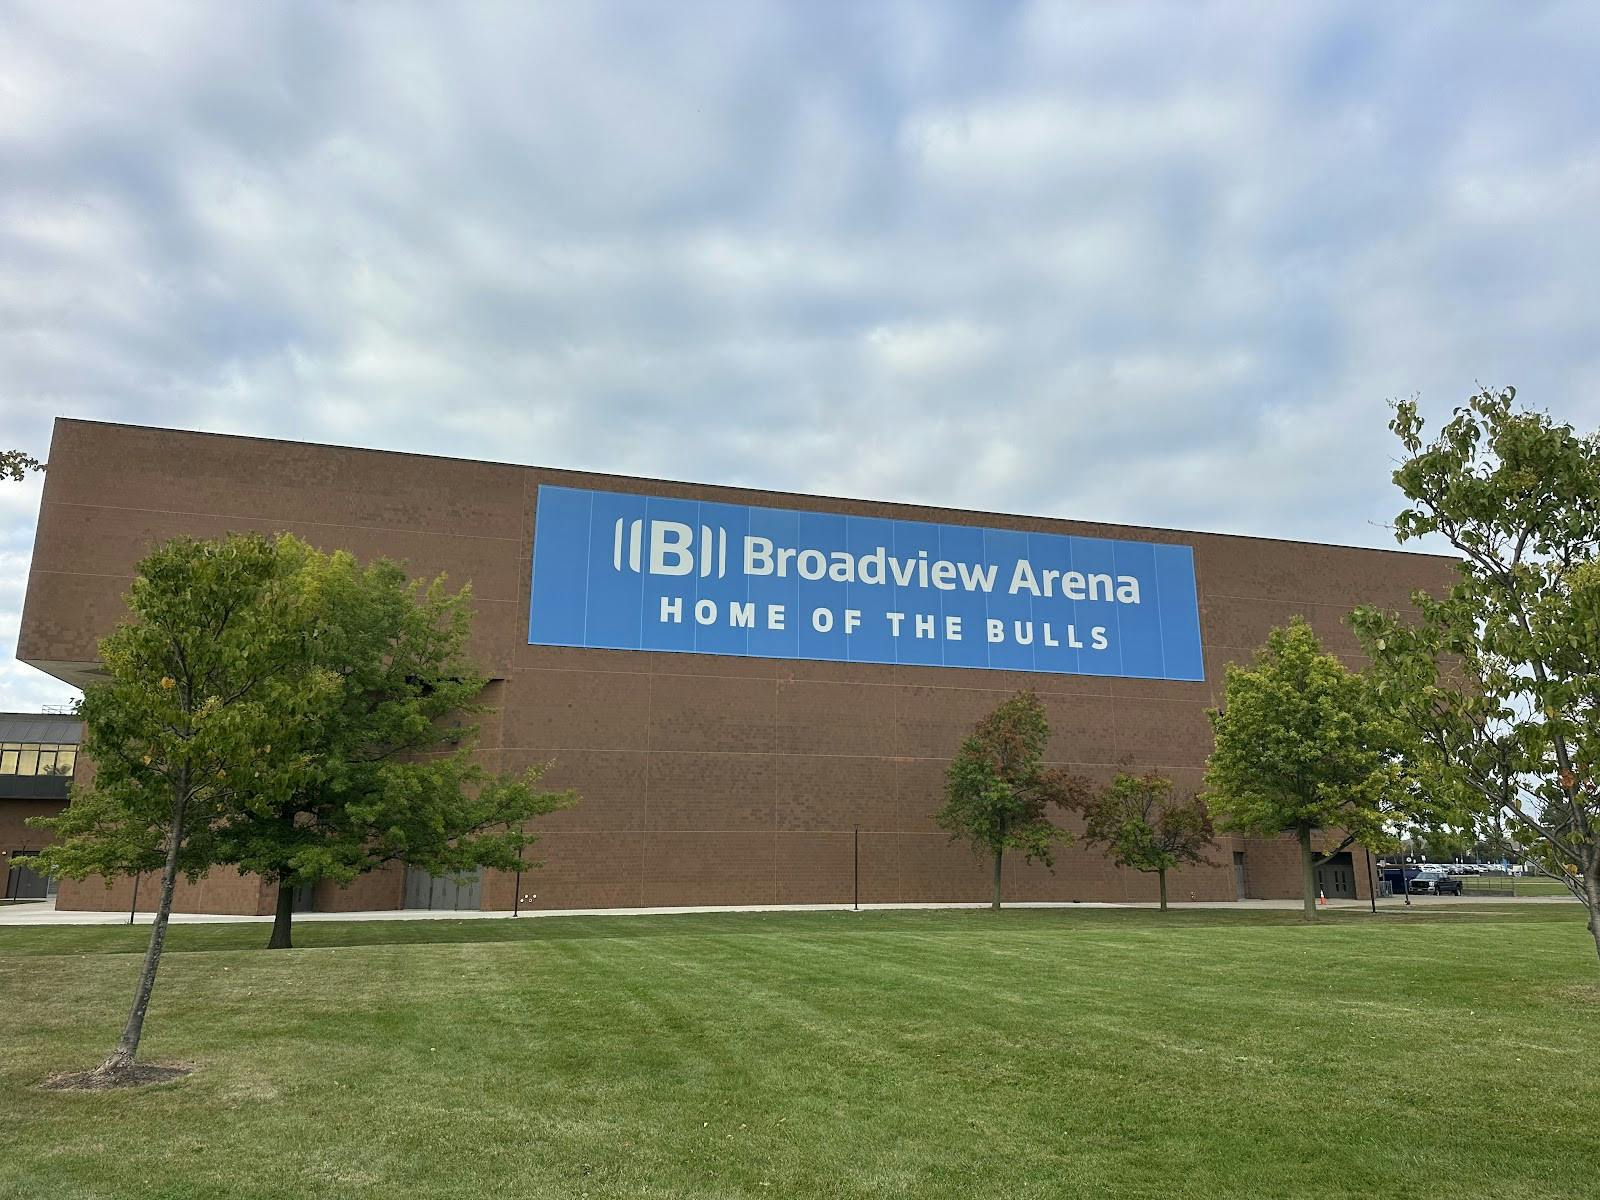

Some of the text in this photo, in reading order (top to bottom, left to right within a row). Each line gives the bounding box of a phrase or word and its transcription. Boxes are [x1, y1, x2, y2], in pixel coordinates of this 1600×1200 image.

[743, 536, 1141, 604] Broadview Arena
[660, 596, 1108, 649] HOME OF THE BULLS
